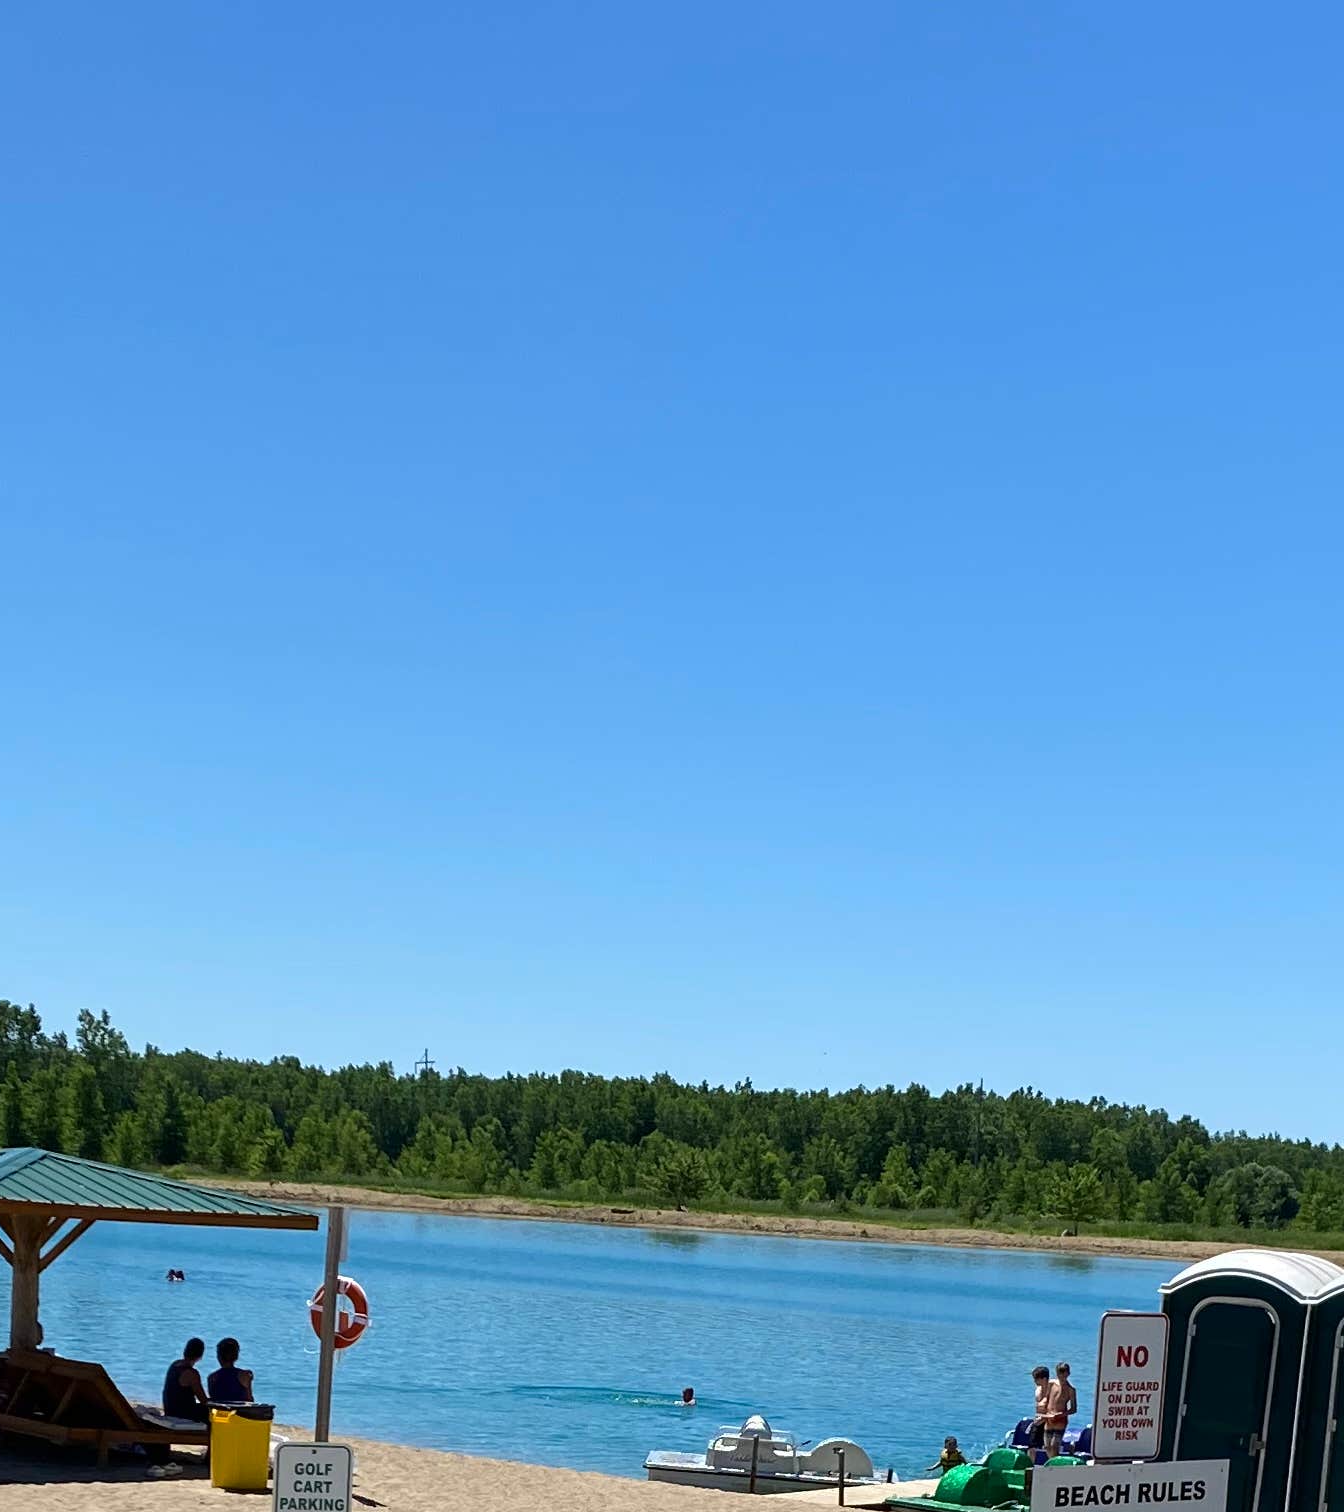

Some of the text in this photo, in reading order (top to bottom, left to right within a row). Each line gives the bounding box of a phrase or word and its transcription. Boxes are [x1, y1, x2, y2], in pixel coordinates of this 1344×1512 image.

[1117, 1345, 1149, 1368] NO
[1102, 1382, 1159, 1391] LIFE GUARD
[1108, 1394, 1152, 1404] ON DUTY
[1108, 1406, 1150, 1416] SWIM AT
[1102, 1418, 1153, 1428] YOUR OWN
[1115, 1431, 1138, 1440] RISK
[294, 1463, 333, 1475] GOLF
[293, 1481, 332, 1493] CART
[1055, 1480, 1206, 1507] BEACH RULES
[279, 1498, 344, 1511] PARKING
